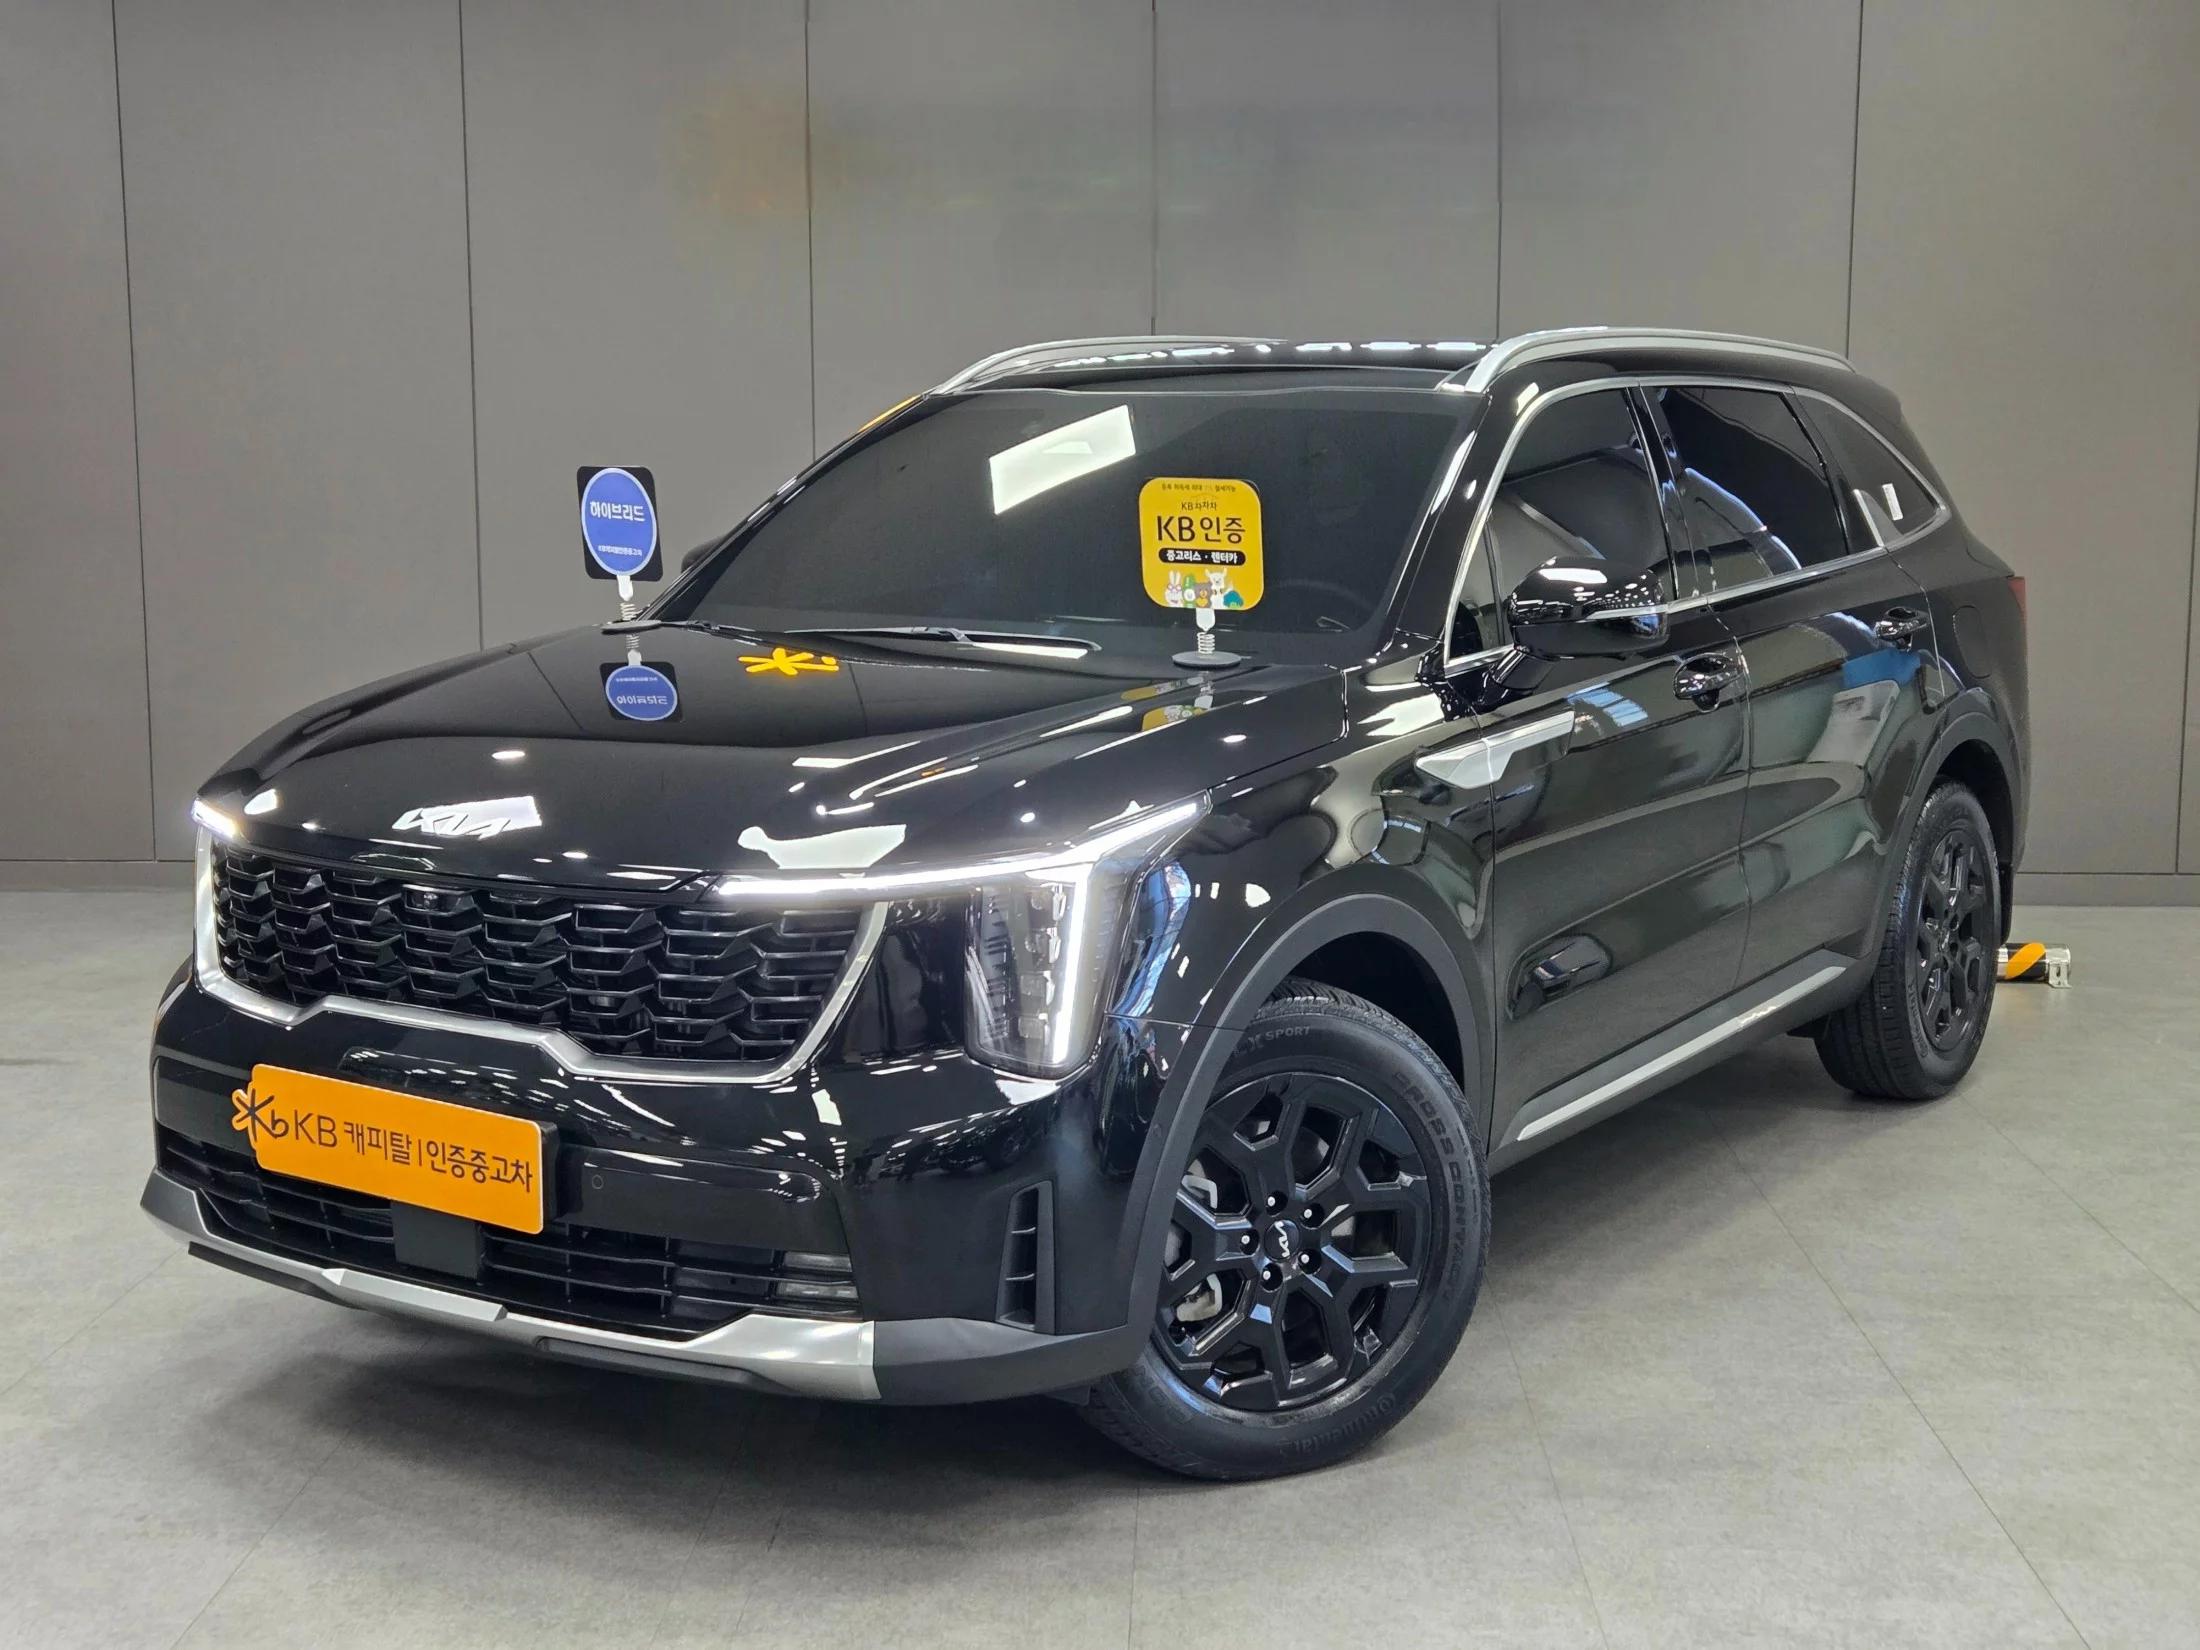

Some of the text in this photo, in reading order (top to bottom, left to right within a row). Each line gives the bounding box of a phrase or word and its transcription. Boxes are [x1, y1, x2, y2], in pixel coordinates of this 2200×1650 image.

[590, 500, 645, 522] 하이브리드
[1181, 501, 1193, 511] KB
[1157, 515, 1246, 545] KB 인증
[1166, 549, 1238, 565] 중고리스 렌터카
[1265, 1025, 1310, 1041] SPORT
[294, 1109, 338, 1147] KB
[343, 1121, 412, 1166] 캐피탈
[425, 1139, 534, 1193] 인증중고차
